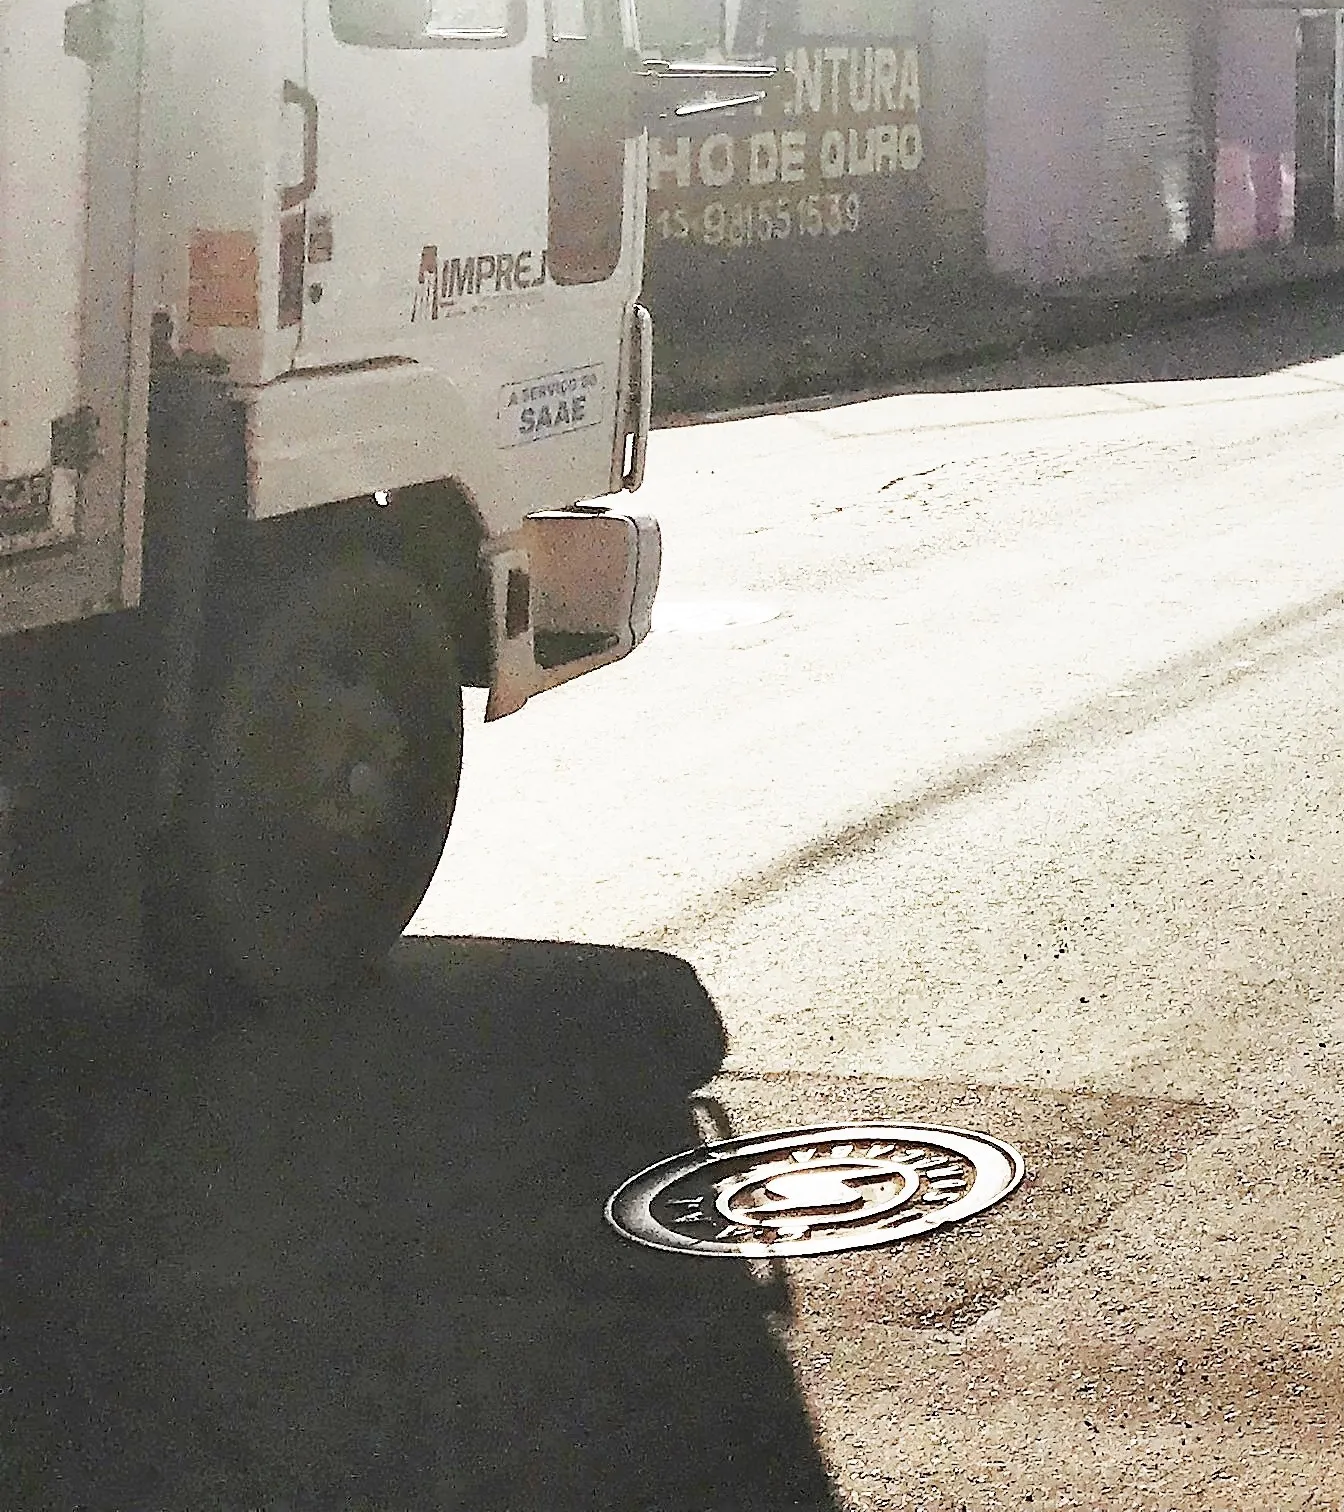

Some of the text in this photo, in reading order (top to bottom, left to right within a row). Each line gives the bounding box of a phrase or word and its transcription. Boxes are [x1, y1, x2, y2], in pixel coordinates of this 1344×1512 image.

[749, 130, 807, 185] DE
[820, 123, 924, 180] OURO
[519, 396, 587, 434] SAAE
